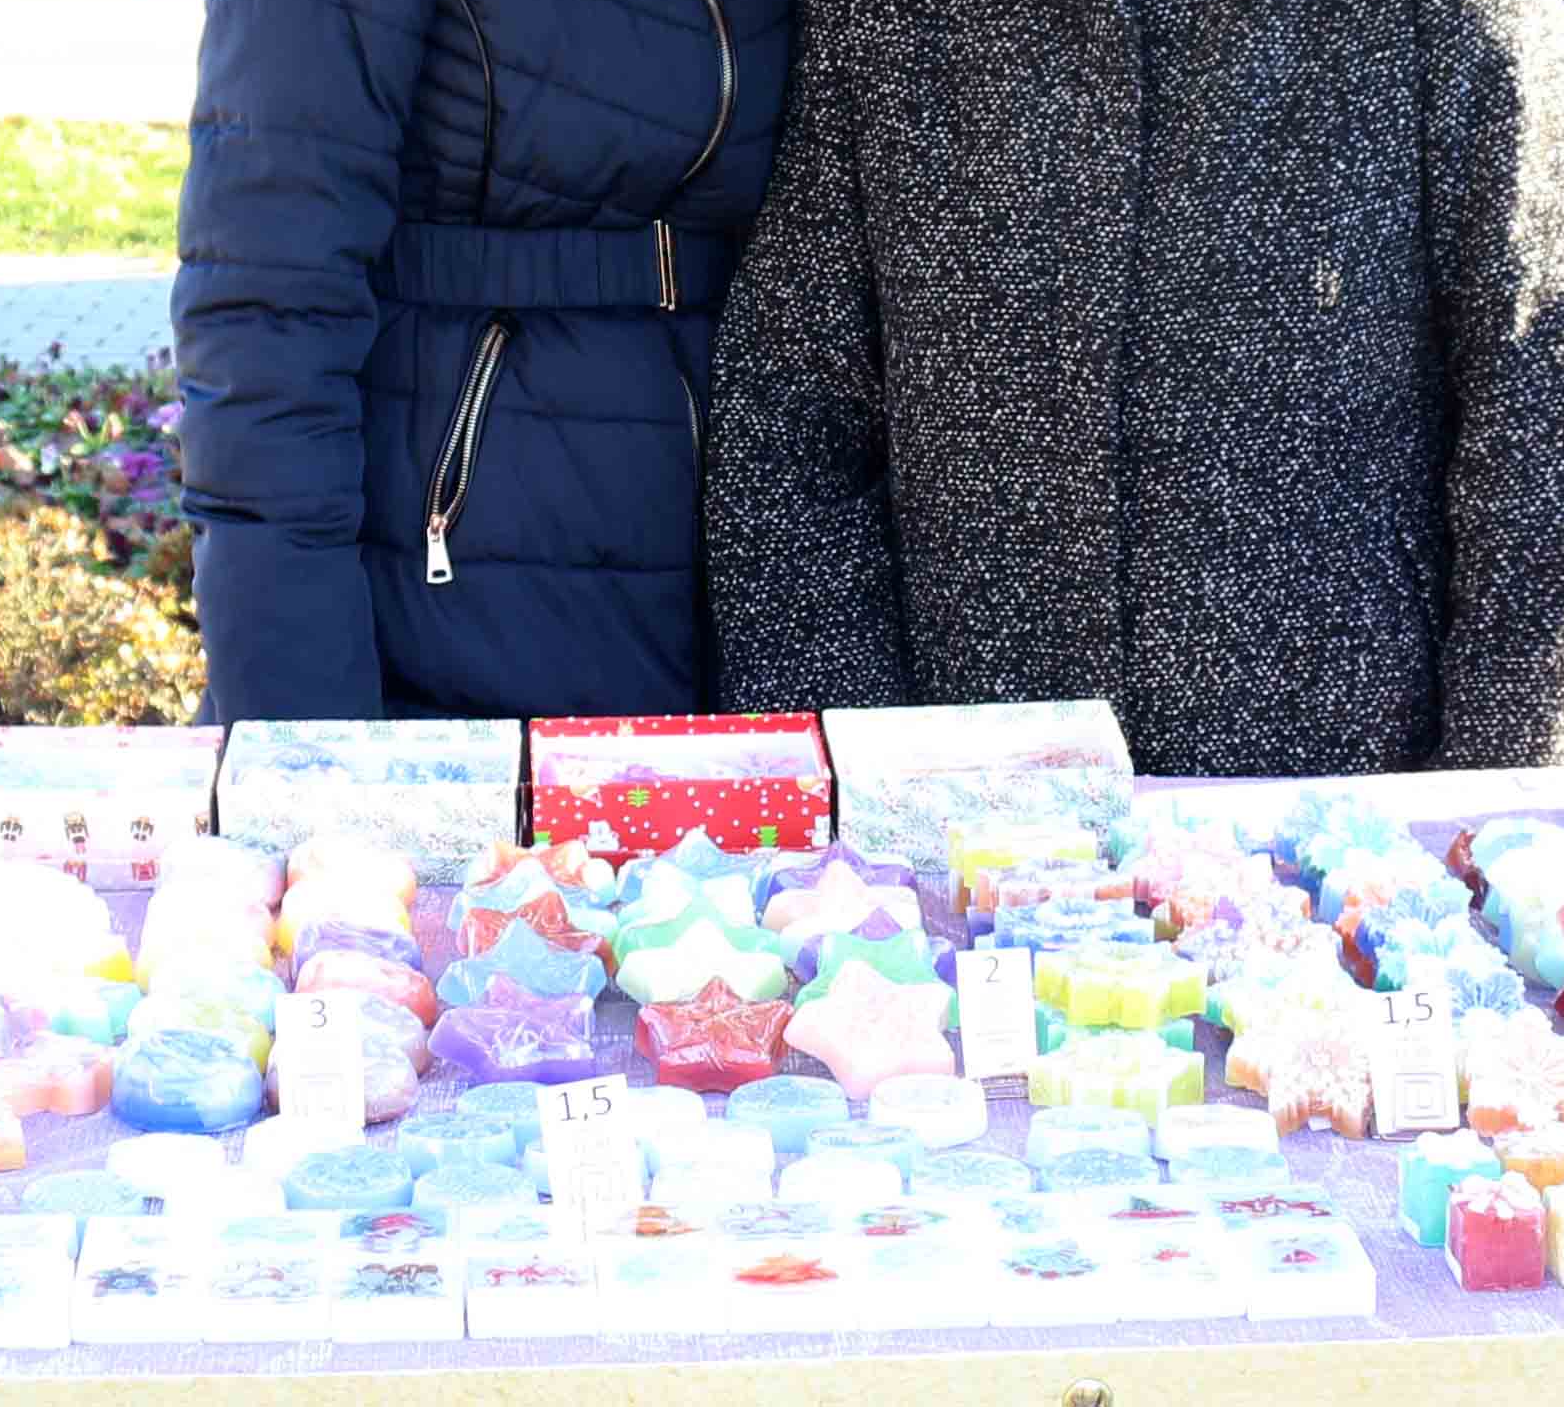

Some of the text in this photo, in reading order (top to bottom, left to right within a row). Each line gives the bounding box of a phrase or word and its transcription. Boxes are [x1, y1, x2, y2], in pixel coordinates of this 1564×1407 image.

[984, 955, 1000, 983] 2
[310, 997, 328, 1028] 3
[1381, 993, 1435, 1027] 1,5
